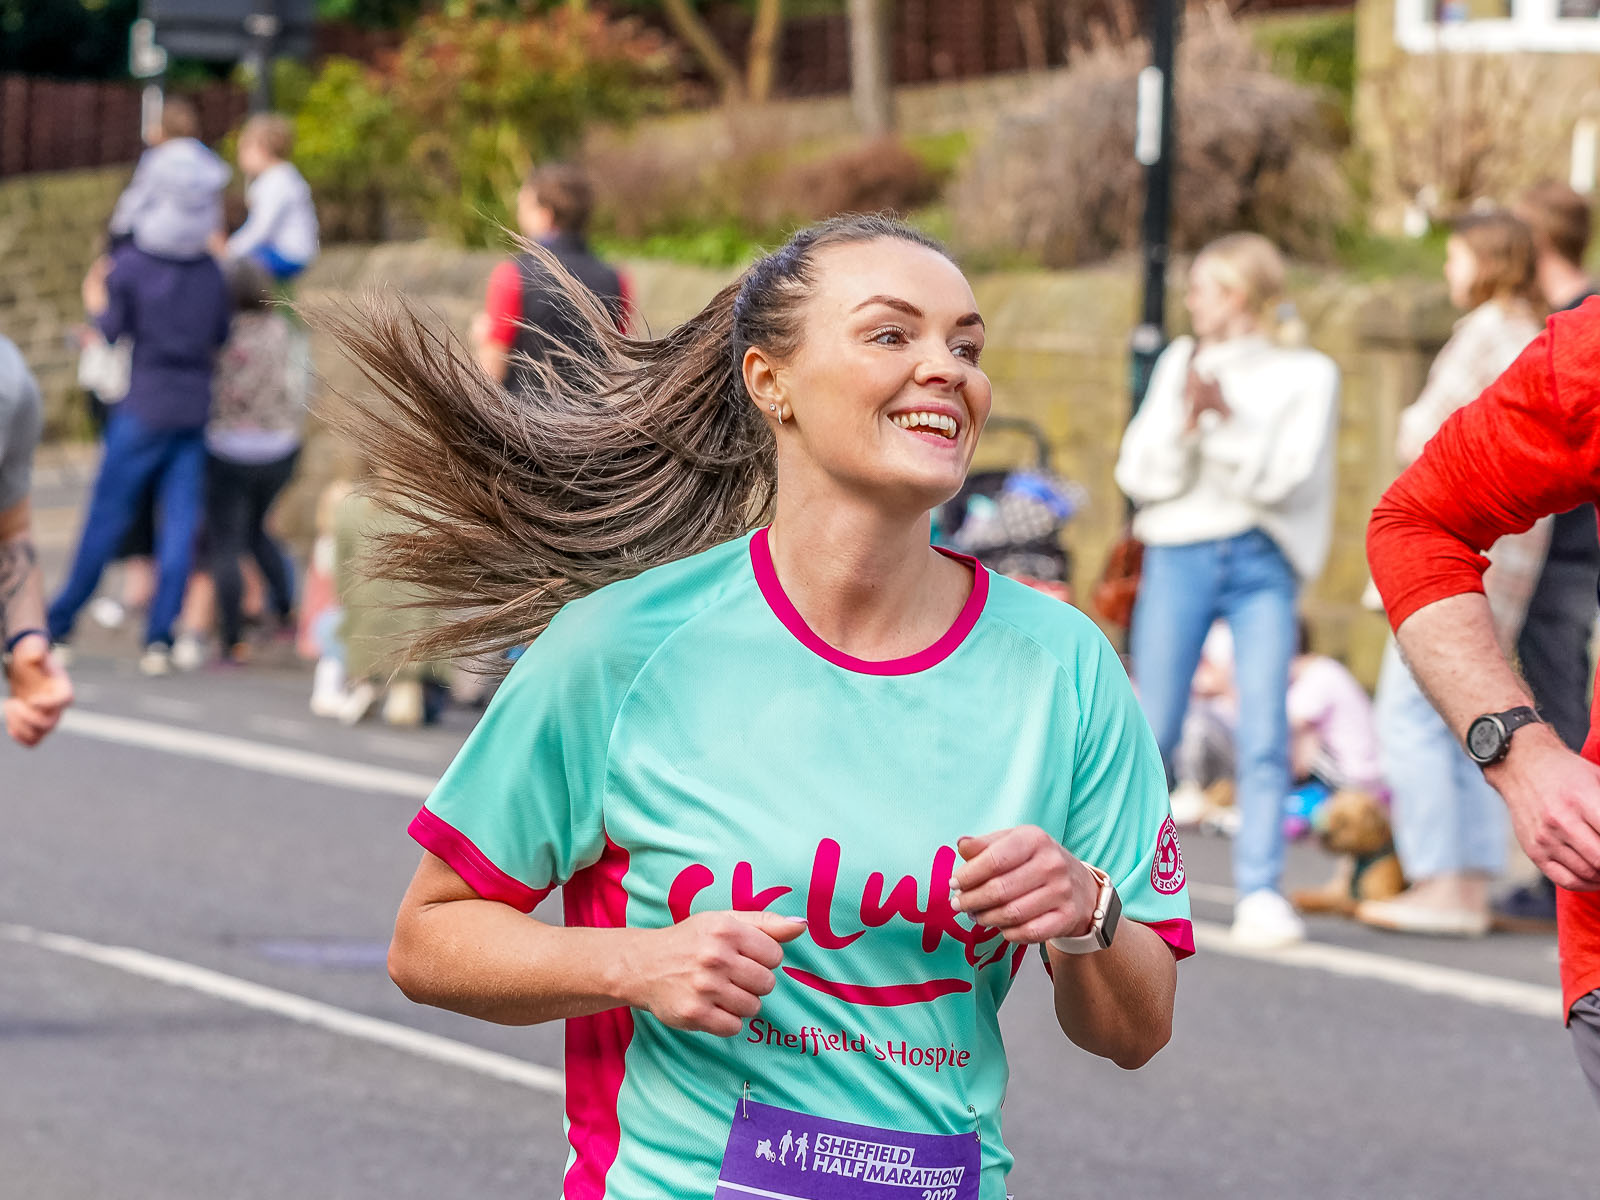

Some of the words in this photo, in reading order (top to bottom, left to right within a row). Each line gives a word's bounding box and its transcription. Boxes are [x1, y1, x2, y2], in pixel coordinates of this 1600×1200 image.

[747, 1018, 887, 1061] Sheffield's
[887, 1040, 971, 1072] Hospie
[816, 1135, 912, 1166] SHEFFIELD
[812, 1154, 866, 1179] HALF
[866, 1164, 963, 1187] MARATHON
